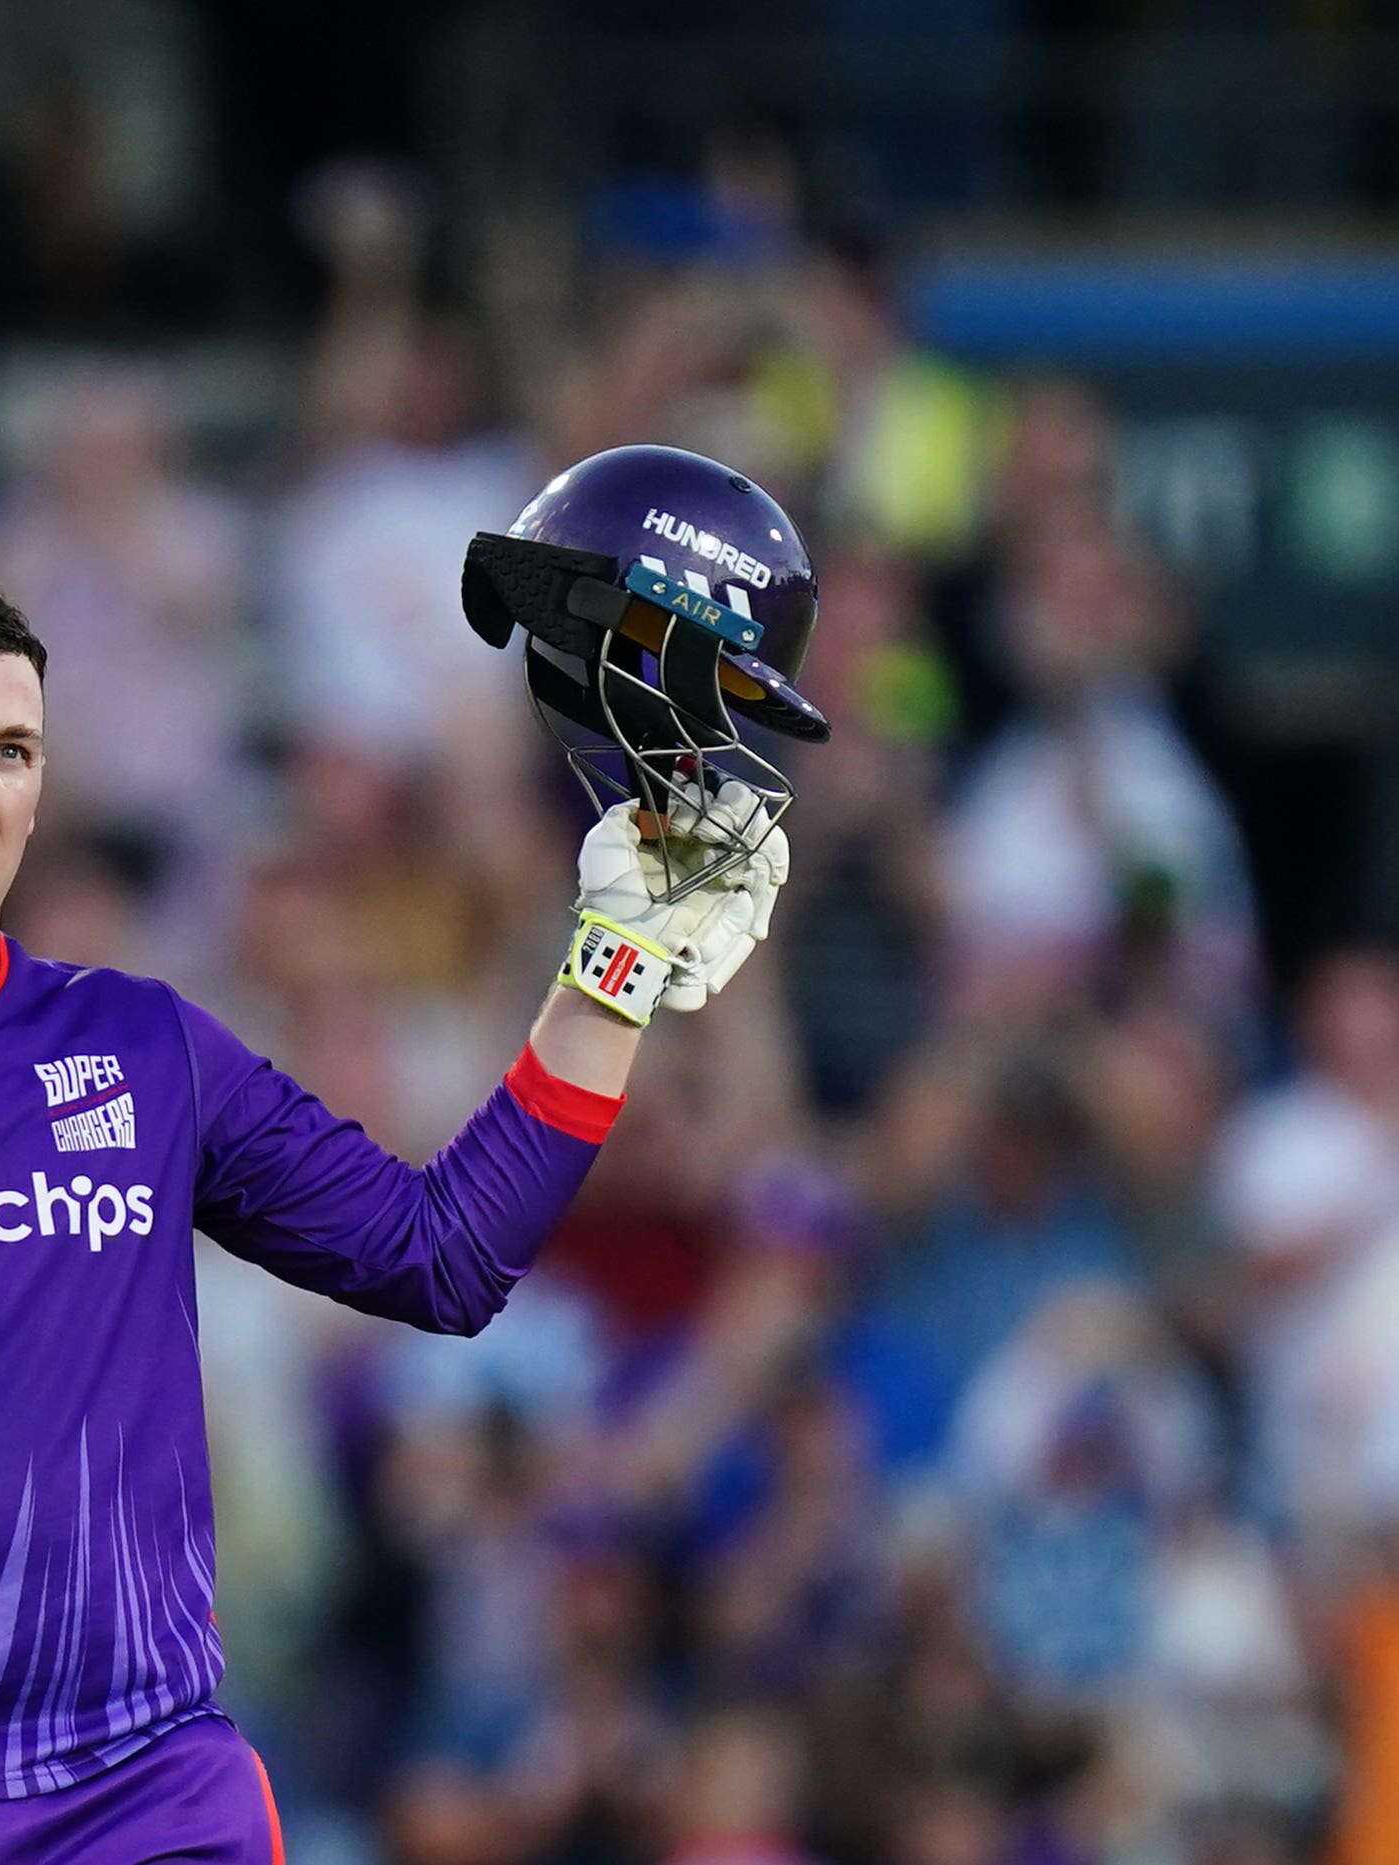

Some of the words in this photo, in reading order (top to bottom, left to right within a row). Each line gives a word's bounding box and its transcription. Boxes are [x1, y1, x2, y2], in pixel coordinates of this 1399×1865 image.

[643, 508, 771, 589] HUNDRED
[672, 593, 721, 625] AIR
[34, 1055, 125, 1107] SUPER
[51, 1092, 136, 1152] CHARGERS
